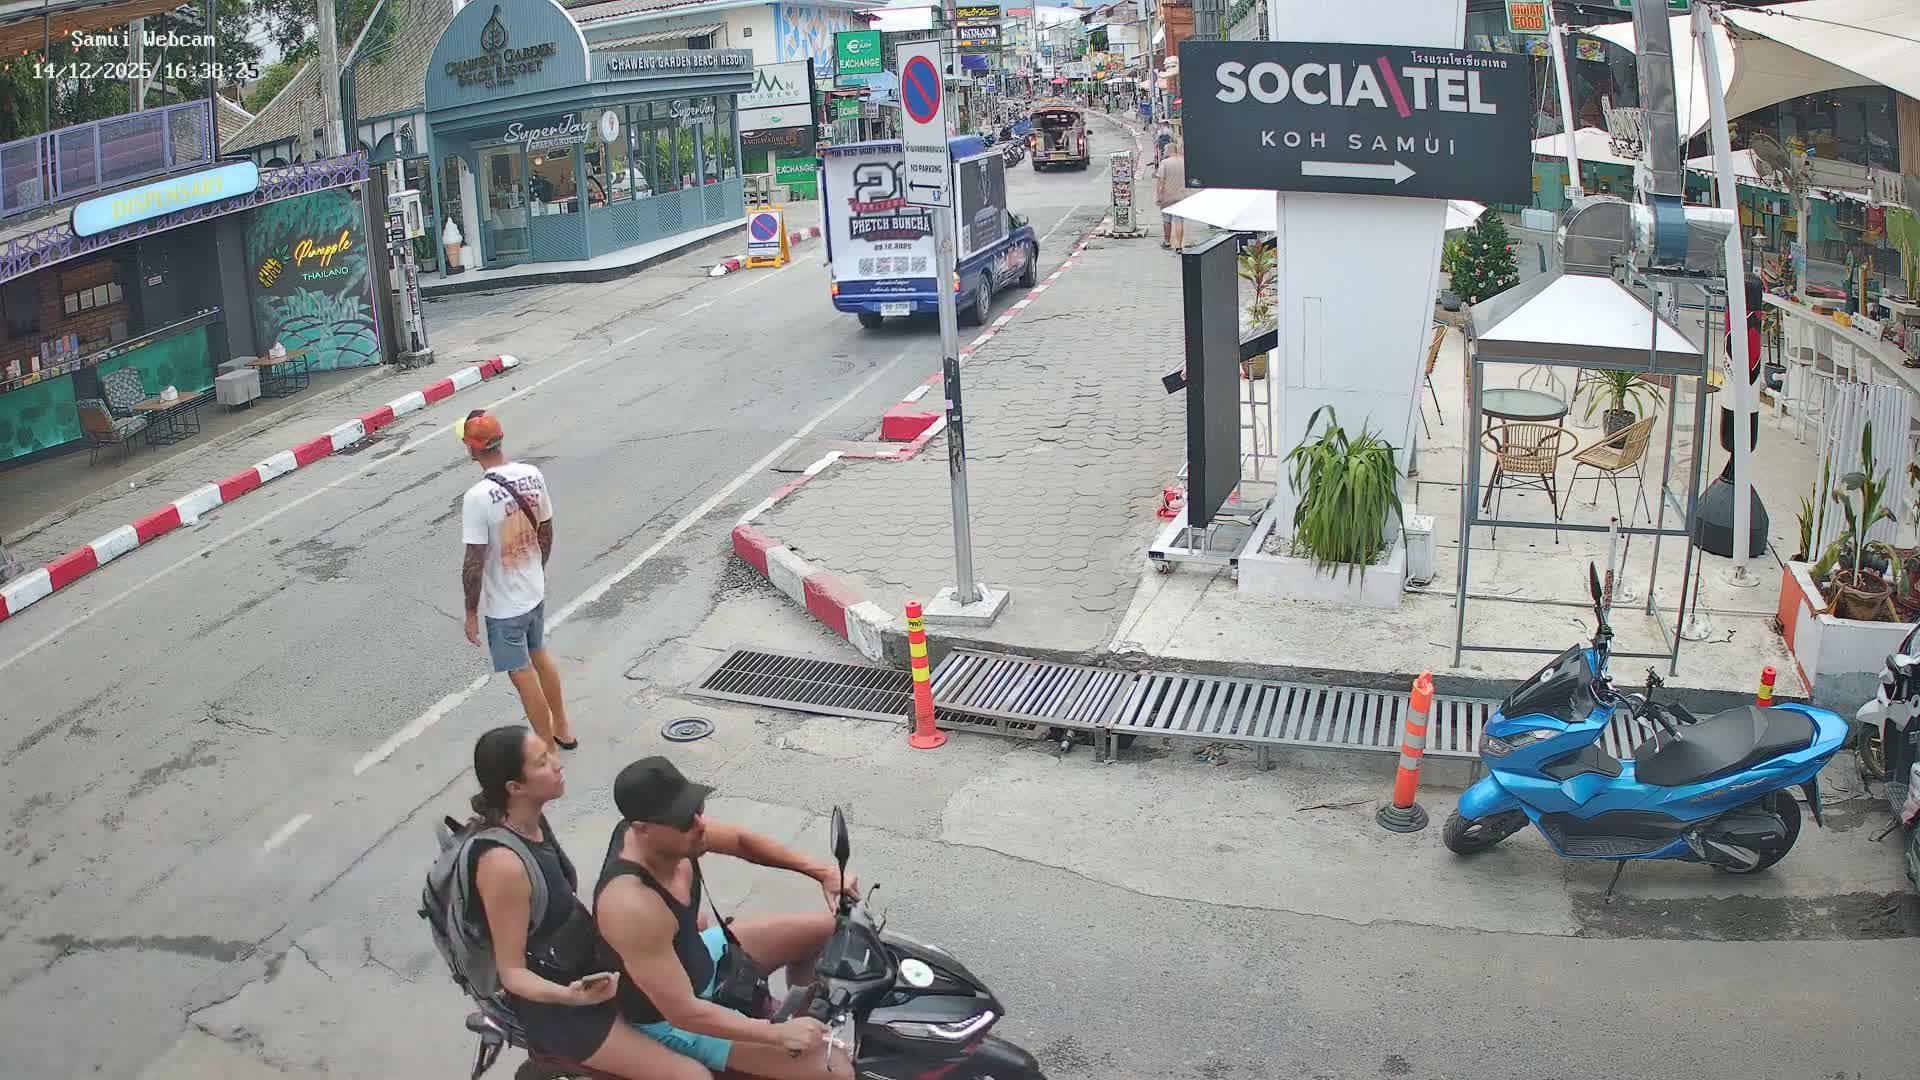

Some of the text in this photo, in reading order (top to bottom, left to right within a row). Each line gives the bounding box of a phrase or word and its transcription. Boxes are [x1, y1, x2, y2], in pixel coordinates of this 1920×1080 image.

[1510, 3, 1543, 17] INDIAN
[1513, 16, 1543, 30] FOOD
[612, 55, 748, 71] CHAWENG GARDEN BEACH RESORT
[840, 57, 880, 69] EXCHANGE
[1260, 129, 1456, 155] KOH SAMUI
[776, 163, 815, 174] EXCHANGE
[911, 164, 943, 173] NO PARKING
[112, 175, 225, 221] DISPENSARY
[852, 218, 890, 235] PHETCH
[892, 216, 930, 231] BUNCHA
[258, 258, 278, 285] PINE
[302, 266, 349, 281] THAILAND
